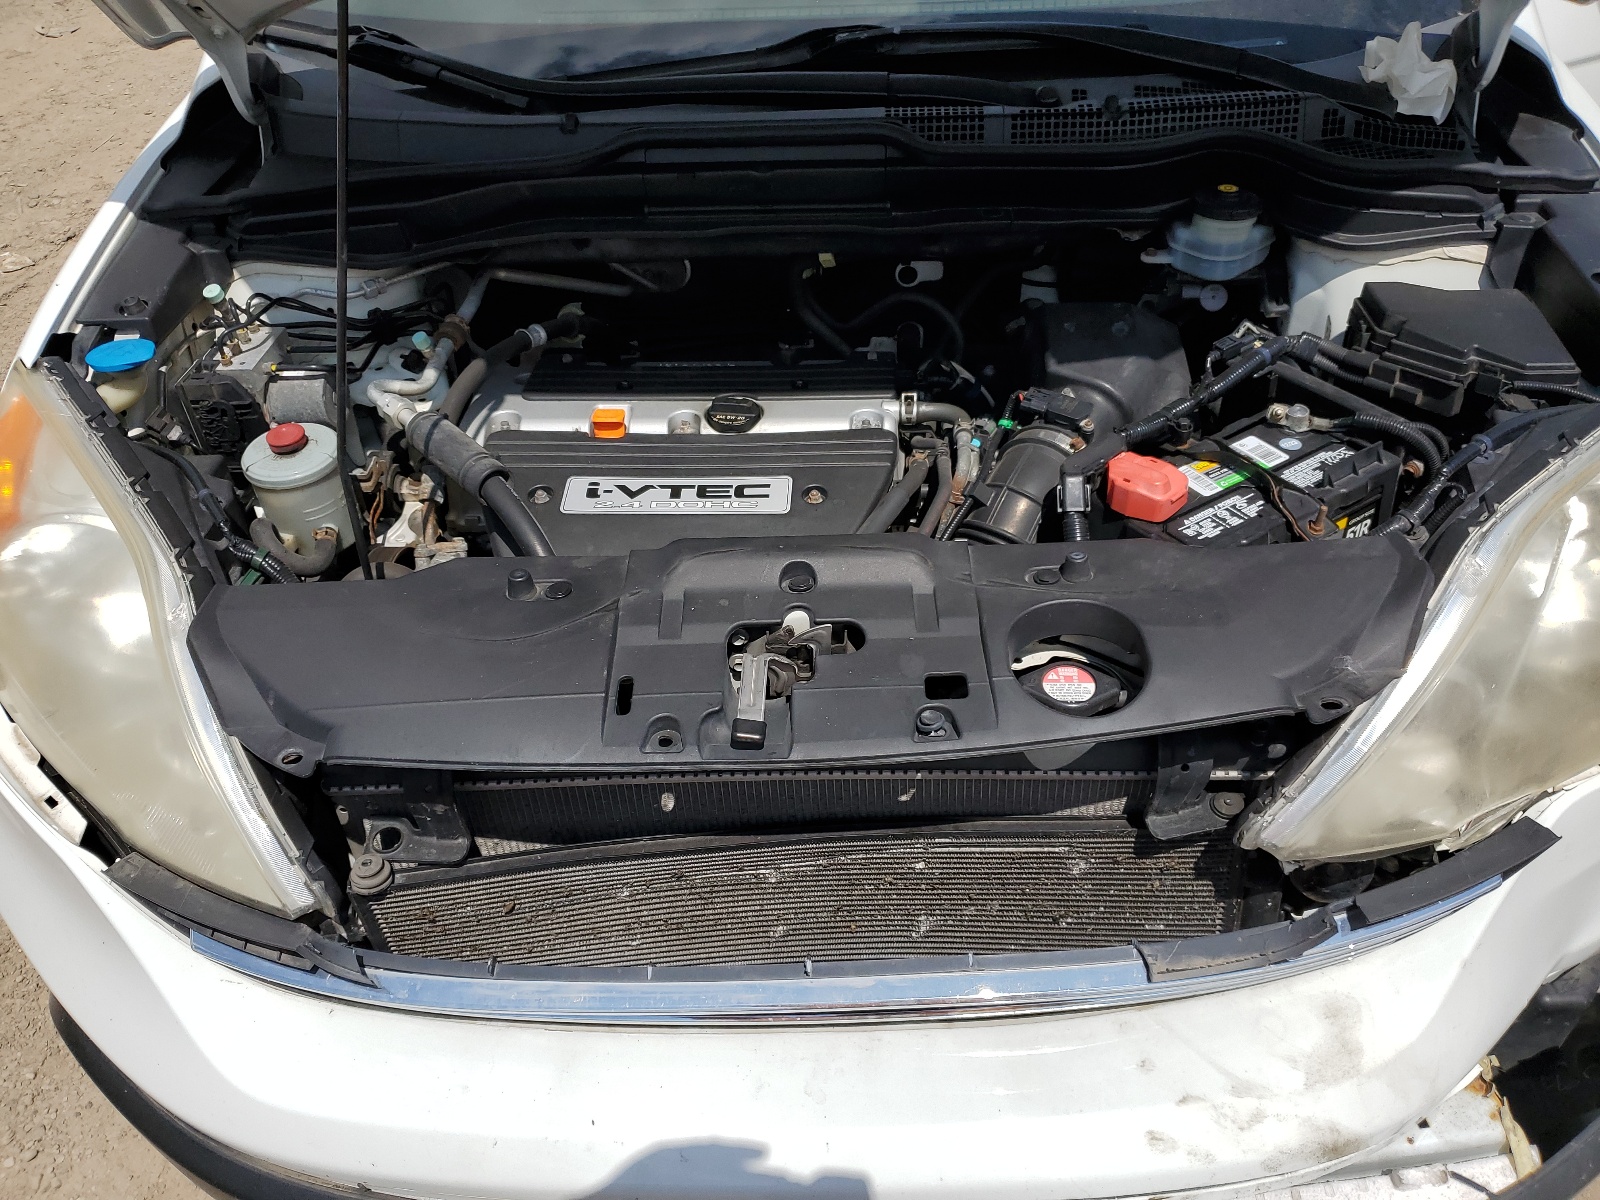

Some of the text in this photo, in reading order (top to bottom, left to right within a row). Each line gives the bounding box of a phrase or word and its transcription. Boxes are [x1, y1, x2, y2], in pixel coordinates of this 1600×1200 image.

[585, 481, 772, 500] i-VTEC
[593, 500, 760, 509] 2.4 DOHC
